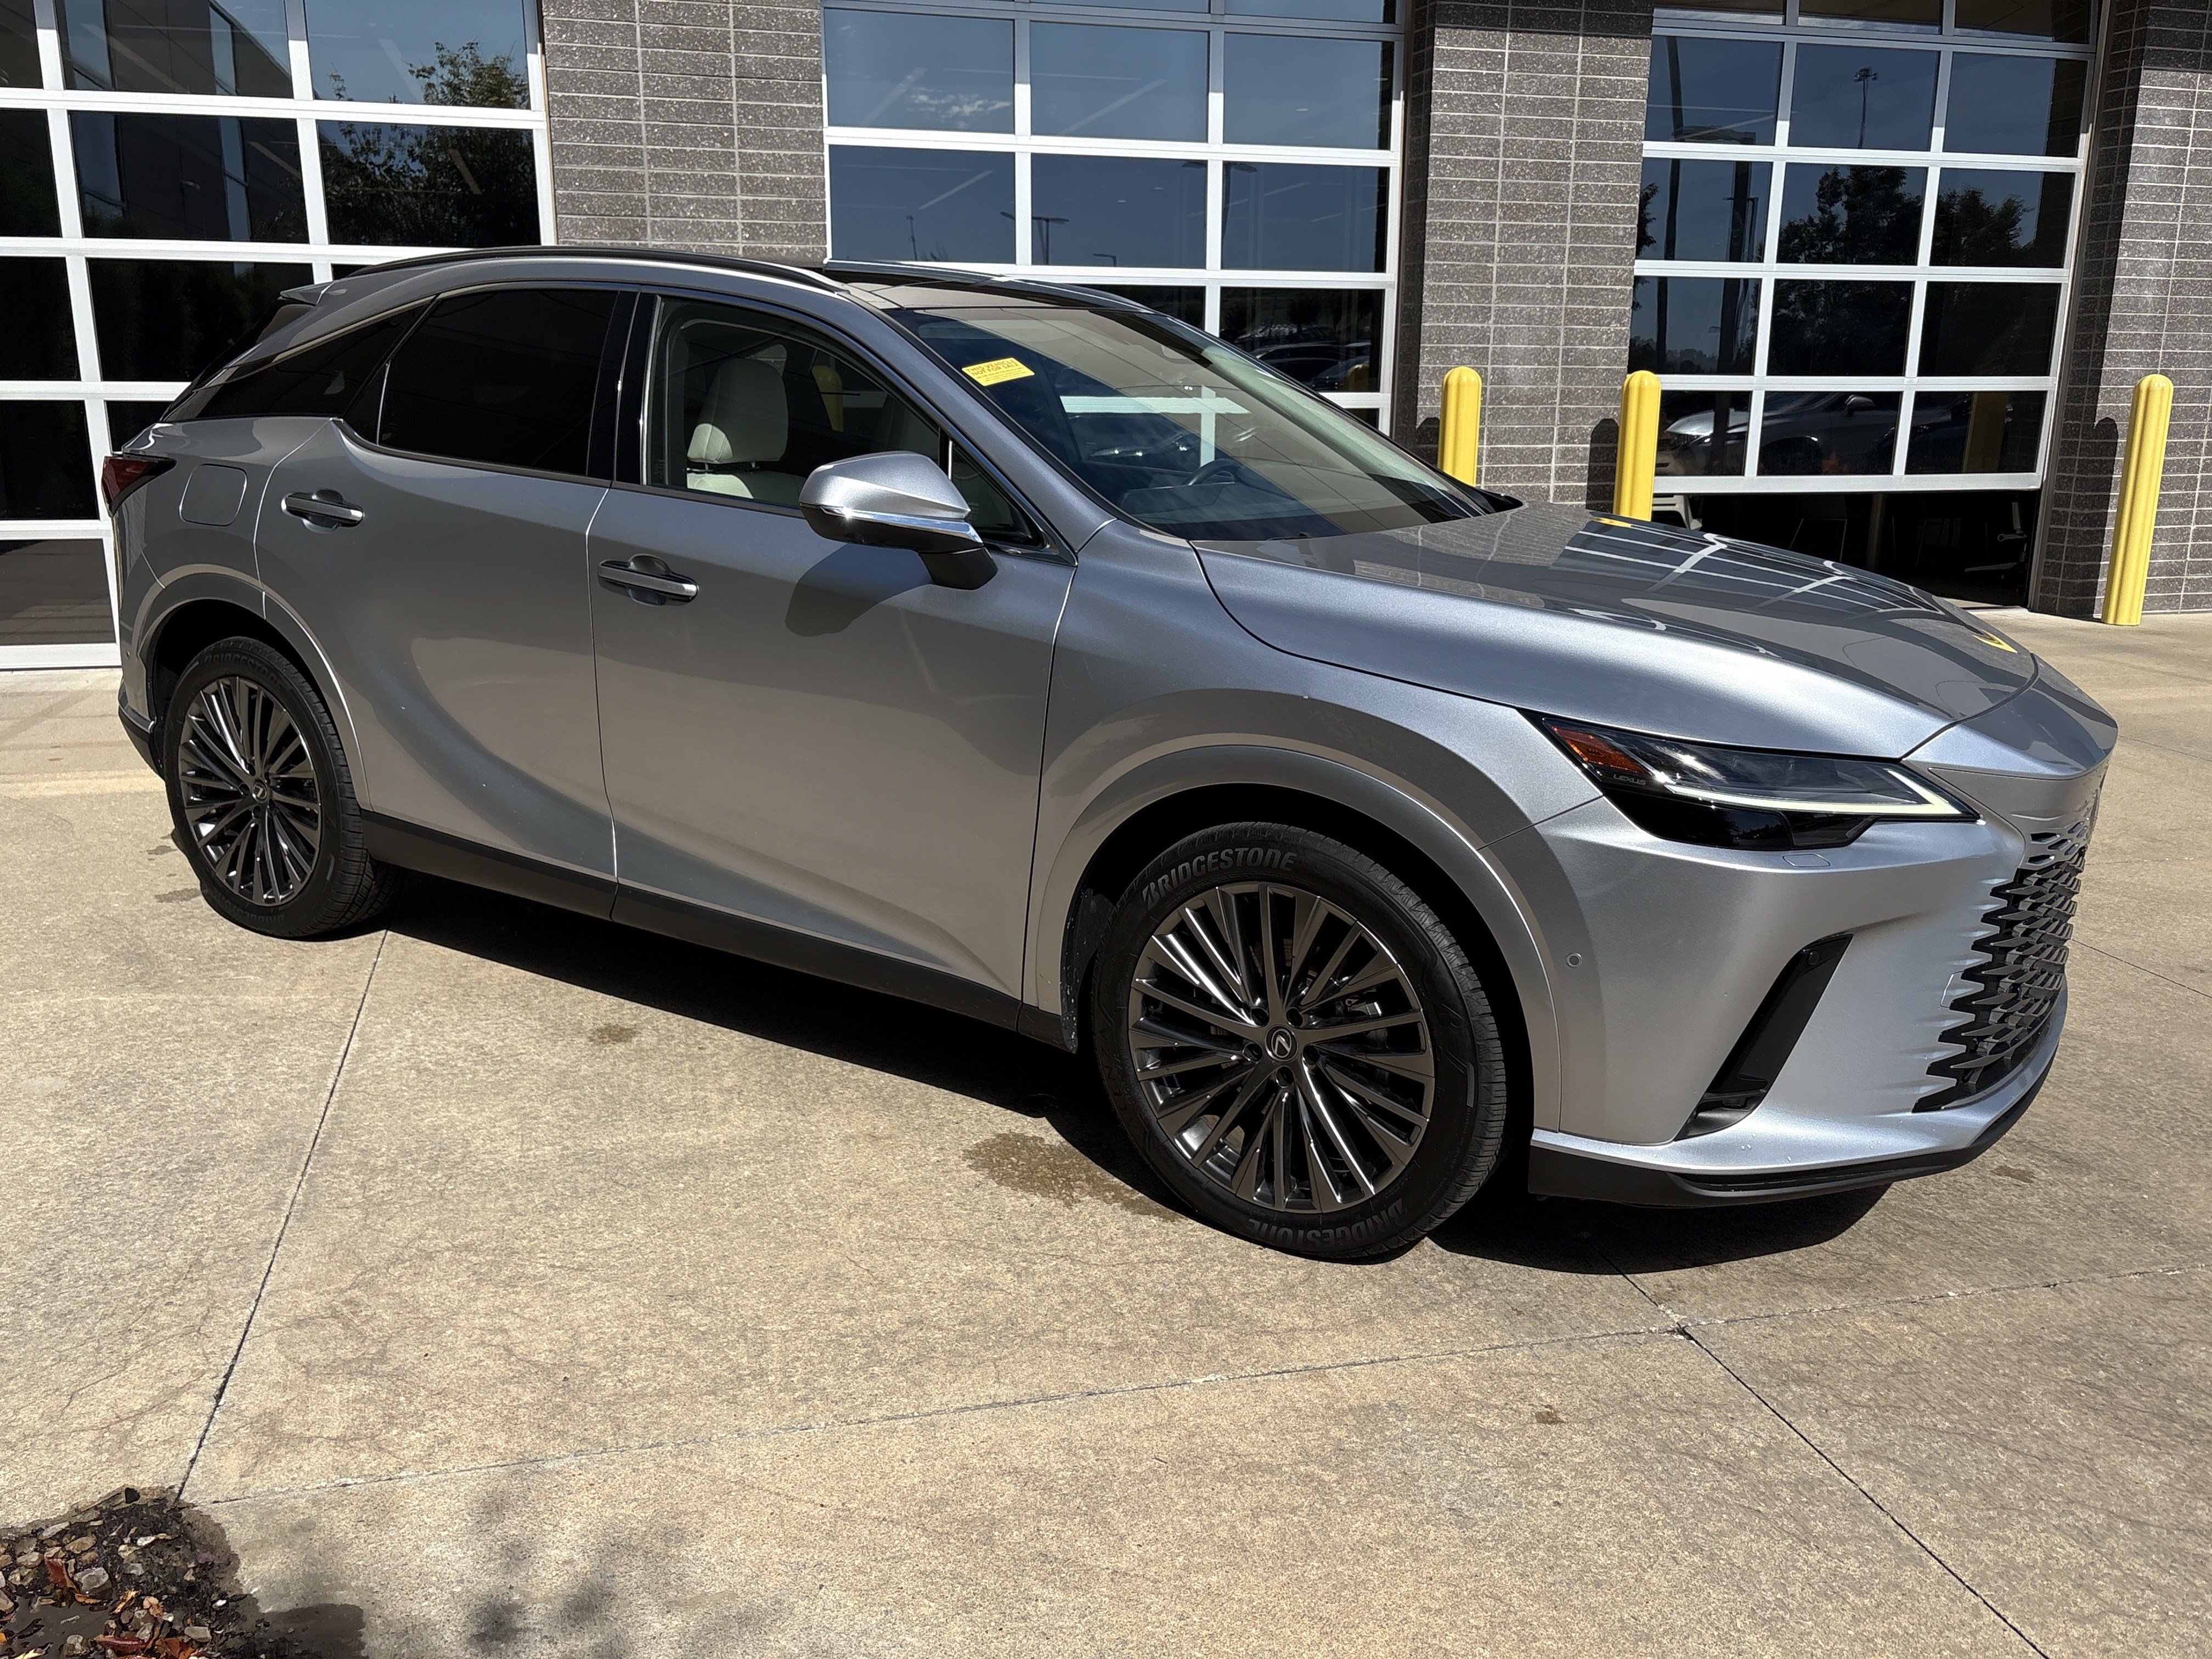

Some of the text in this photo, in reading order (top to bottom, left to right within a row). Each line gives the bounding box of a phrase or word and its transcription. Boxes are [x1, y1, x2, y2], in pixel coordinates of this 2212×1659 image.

[966, 364, 985, 373] THIS
[985, 359, 1017, 369] VEHICLE
[970, 368, 988, 376] NOT
[1613, 774, 1646, 786] LEXUS
[1142, 847, 1297, 910] BRIDGESTONE
[1248, 1198, 1406, 1249] BRIDGESTONE
